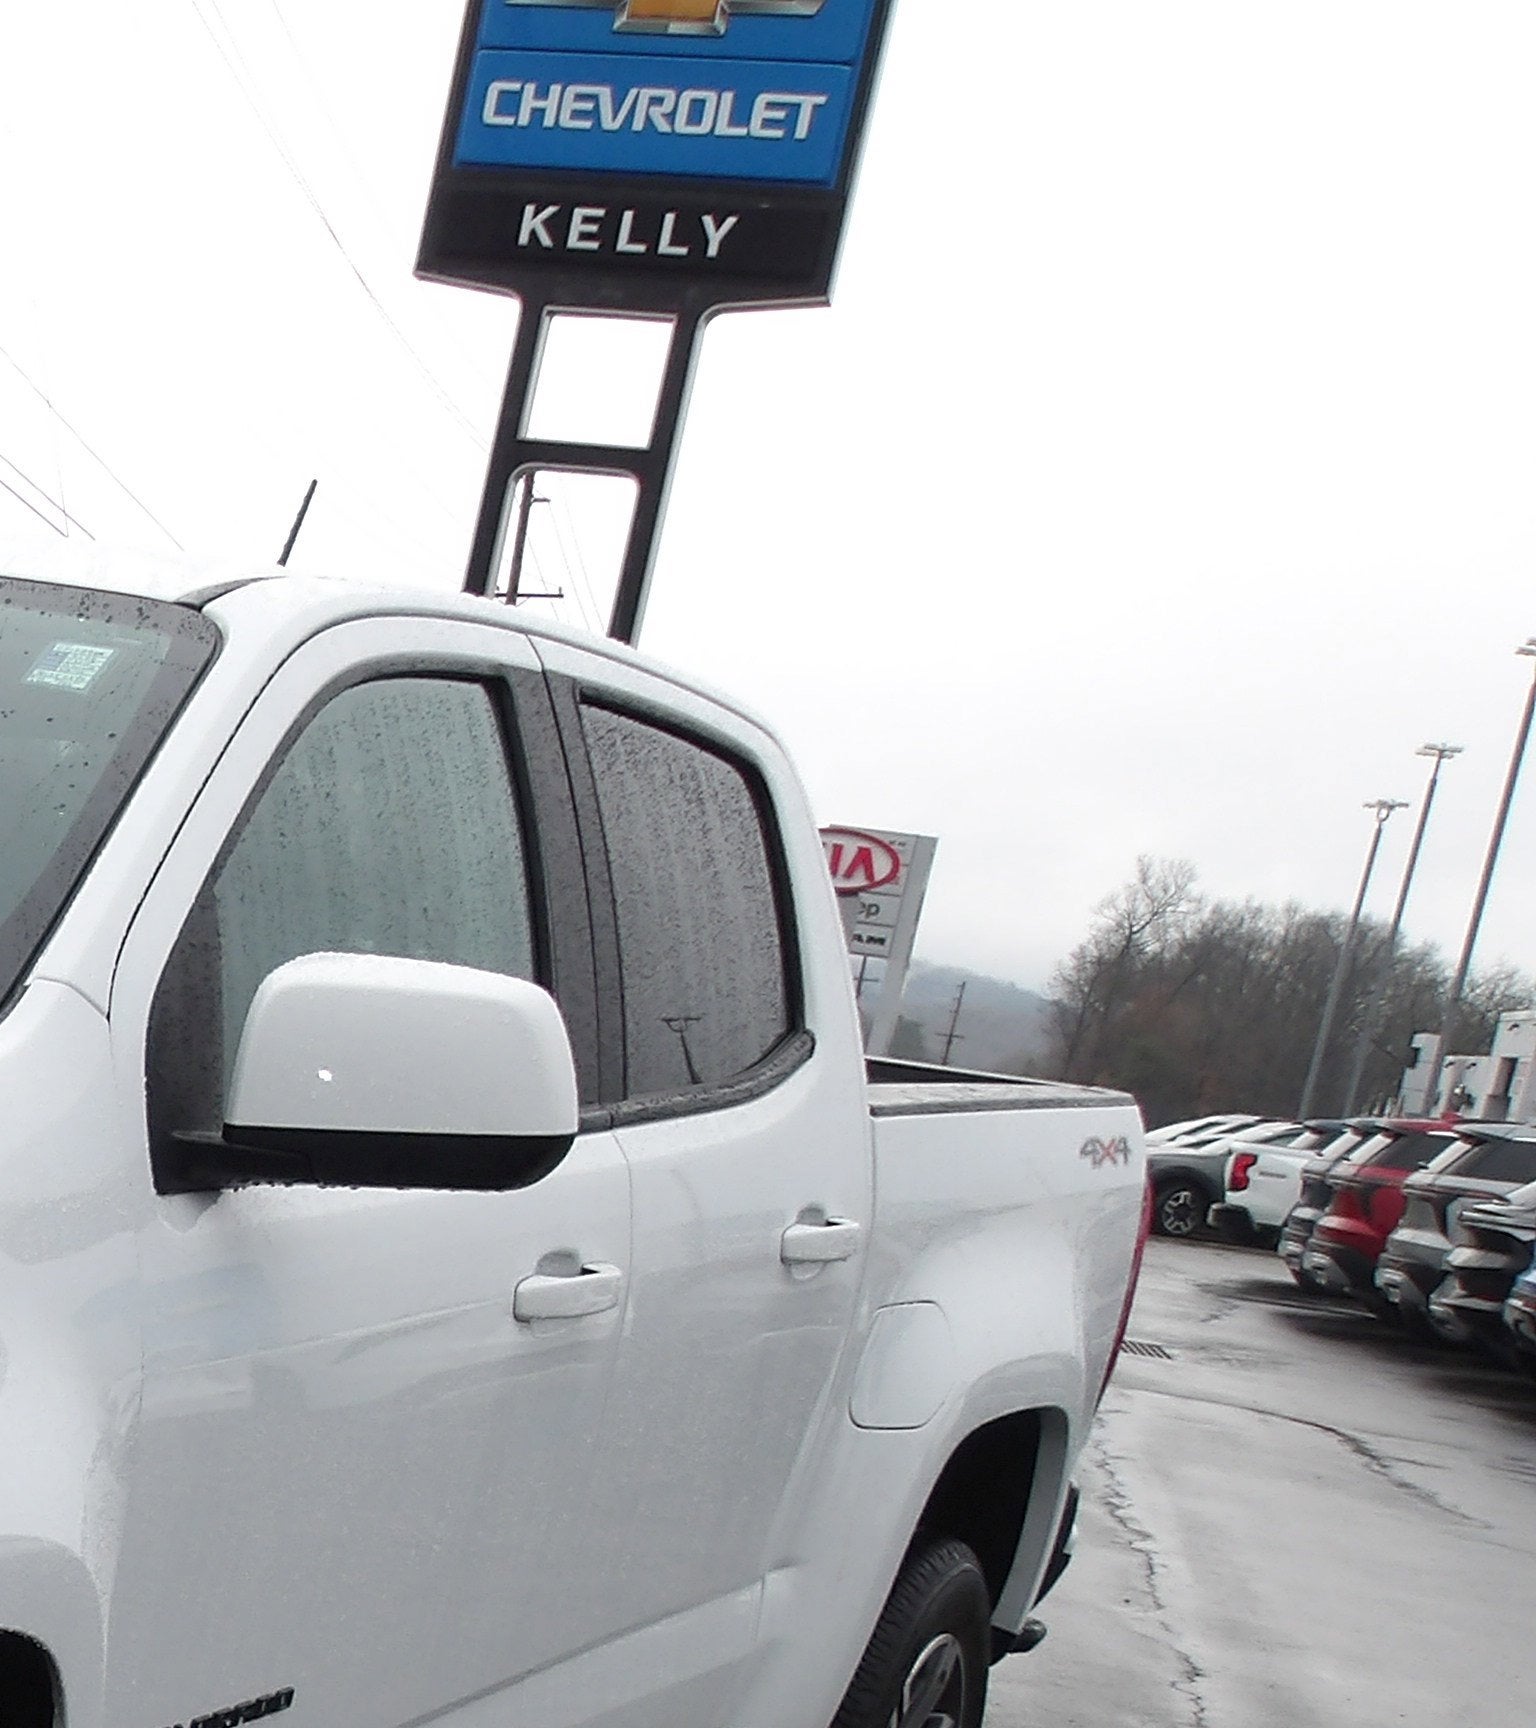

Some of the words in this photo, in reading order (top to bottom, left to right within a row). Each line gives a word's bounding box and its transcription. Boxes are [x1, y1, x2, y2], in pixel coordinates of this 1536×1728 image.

[482, 79, 827, 140] CHEVROLET
[518, 204, 739, 258] KELLY
[822, 842, 875, 884] IA
